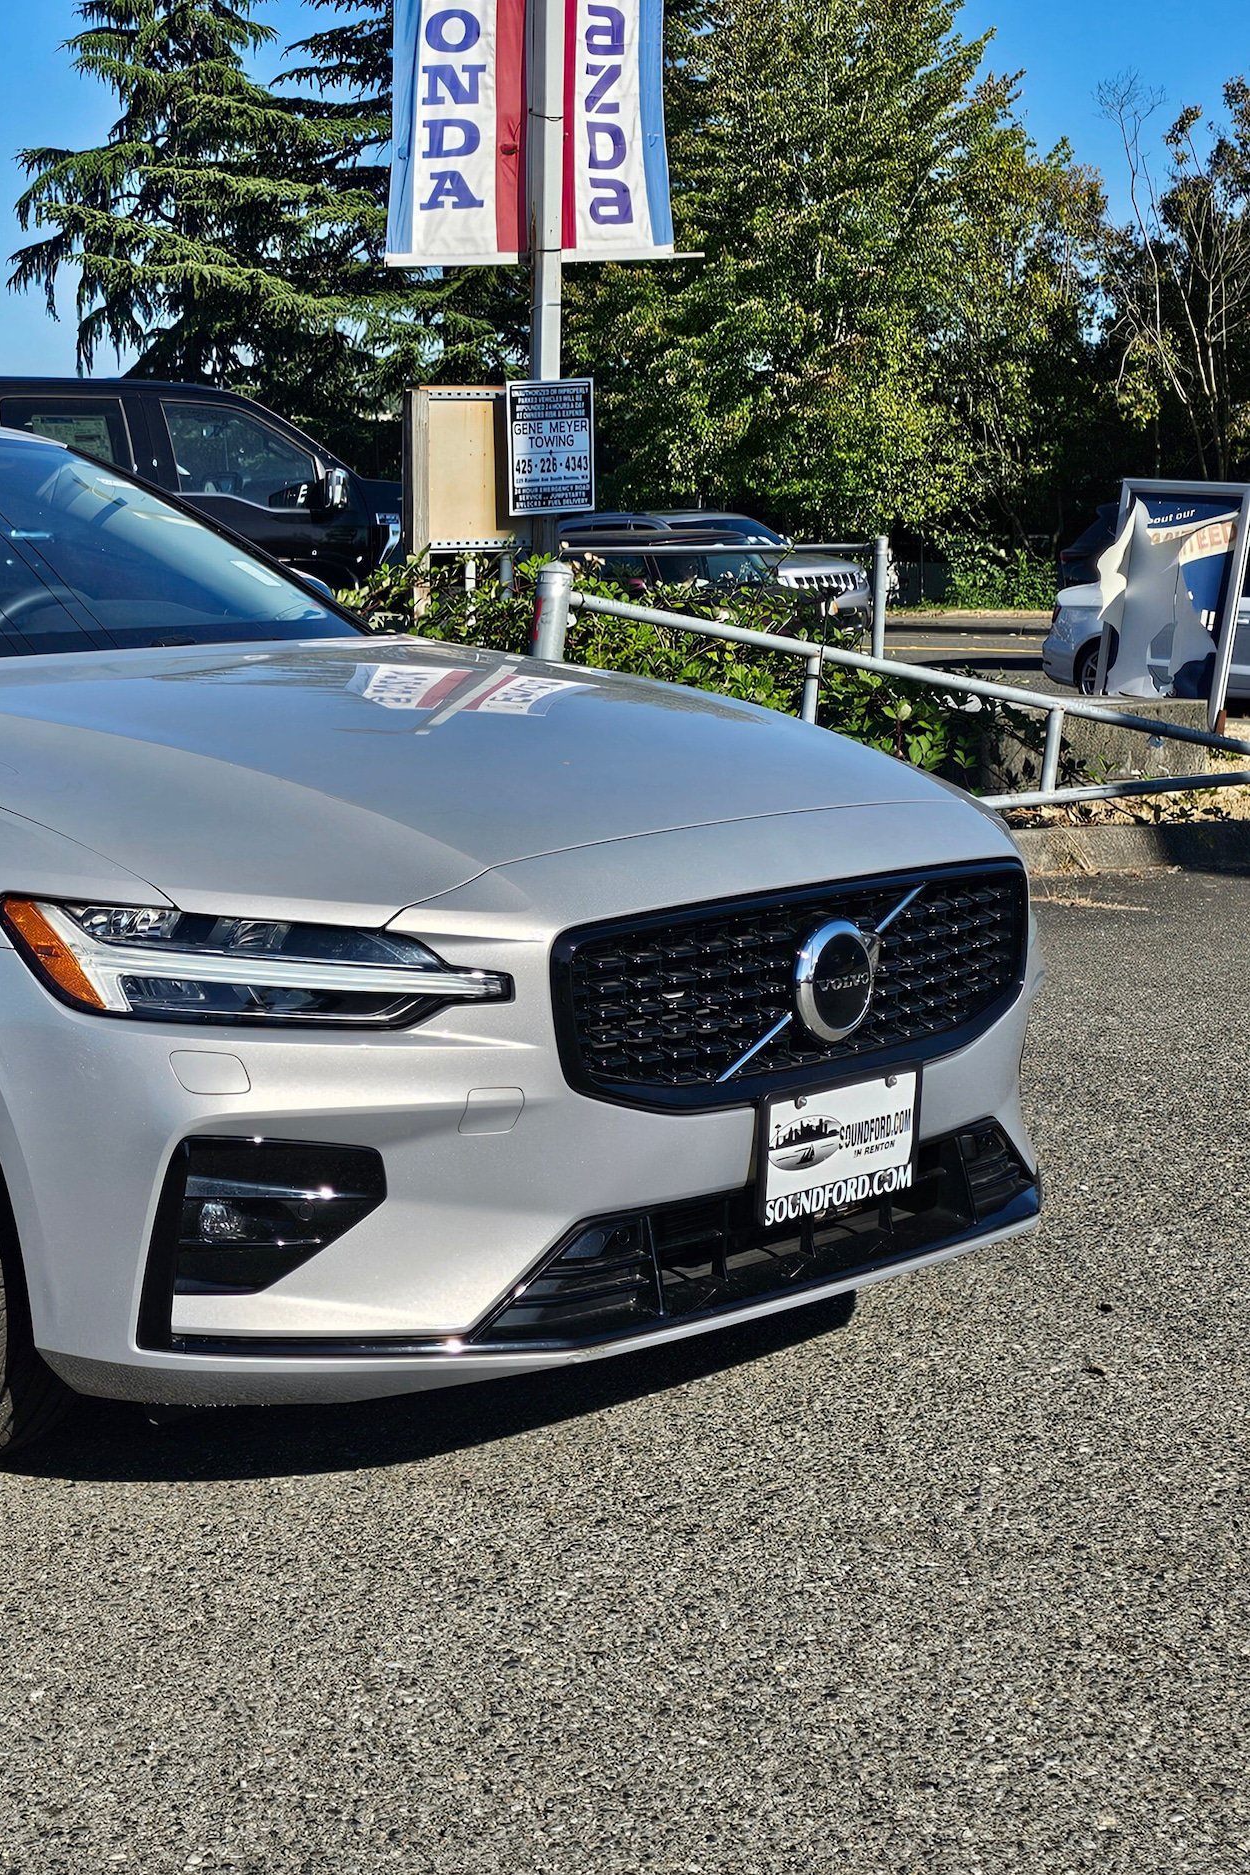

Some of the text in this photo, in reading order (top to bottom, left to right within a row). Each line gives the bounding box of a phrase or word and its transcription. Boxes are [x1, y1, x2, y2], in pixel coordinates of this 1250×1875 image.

[420, 9, 486, 211] ONDA
[514, 420, 588, 435] GENE MEYER
[529, 434, 574, 449] TOWING
[1176, 509, 1195, 520] our
[816, 971, 870, 992] VOLVO
[838, 1108, 911, 1150] SOUNDFORD.COM
[864, 1140, 895, 1155] RENTON
[765, 1162, 912, 1226] SOUNDFORD.COM
